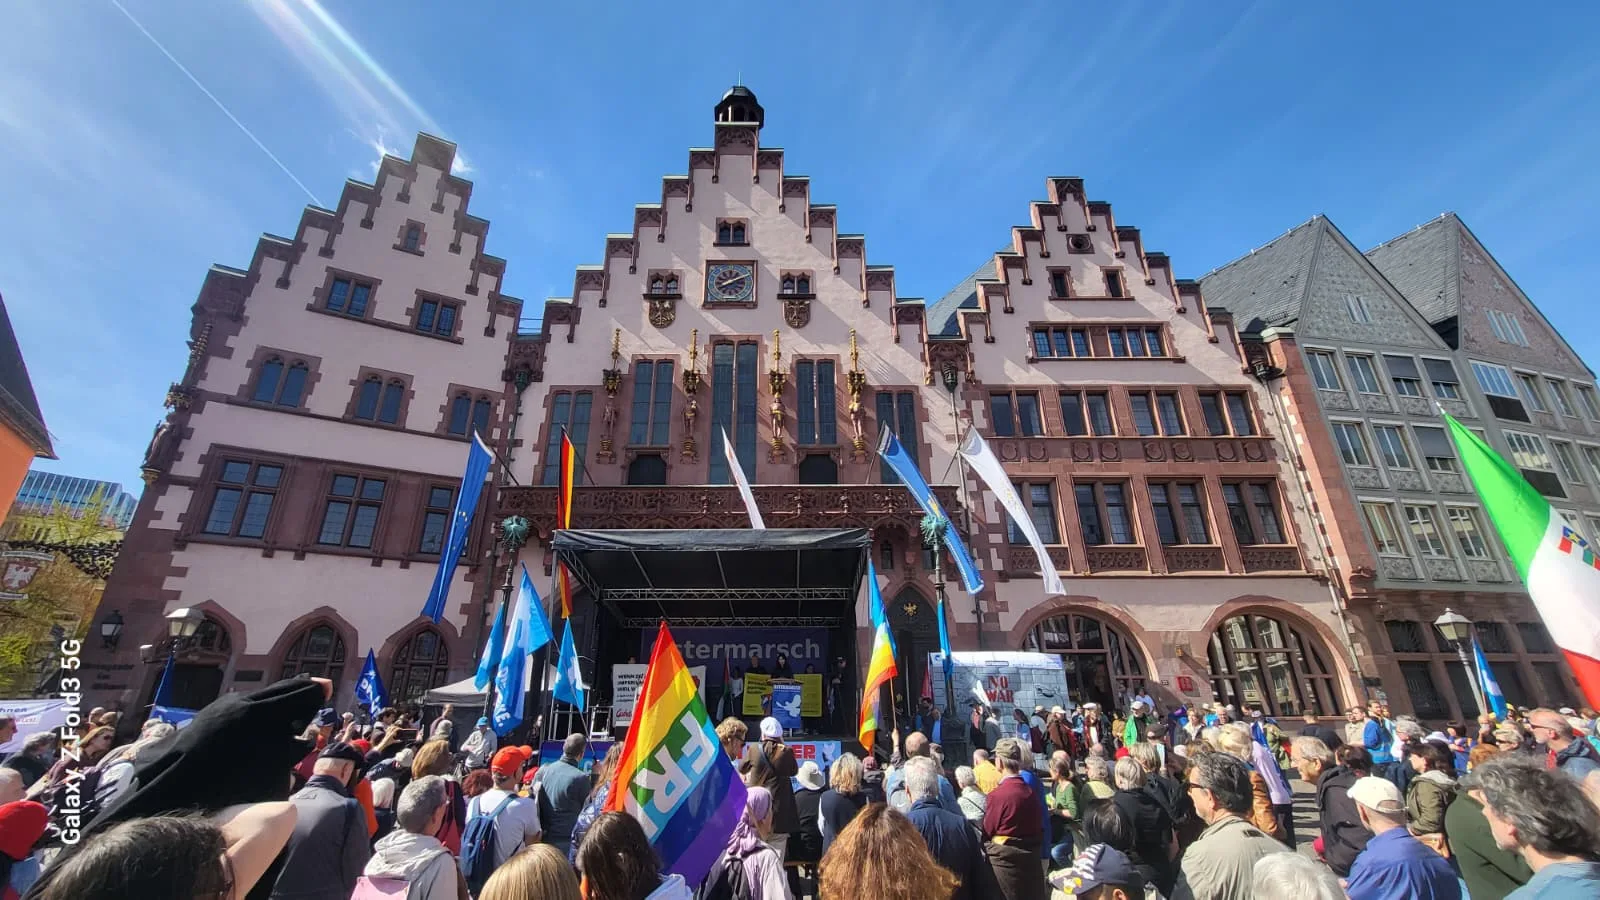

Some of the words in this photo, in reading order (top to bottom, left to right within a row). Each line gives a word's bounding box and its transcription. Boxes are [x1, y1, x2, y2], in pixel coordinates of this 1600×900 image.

[651, 638, 821, 659] termarsch
[987, 675, 1009, 689] NO
[984, 689, 1015, 703] WAR
